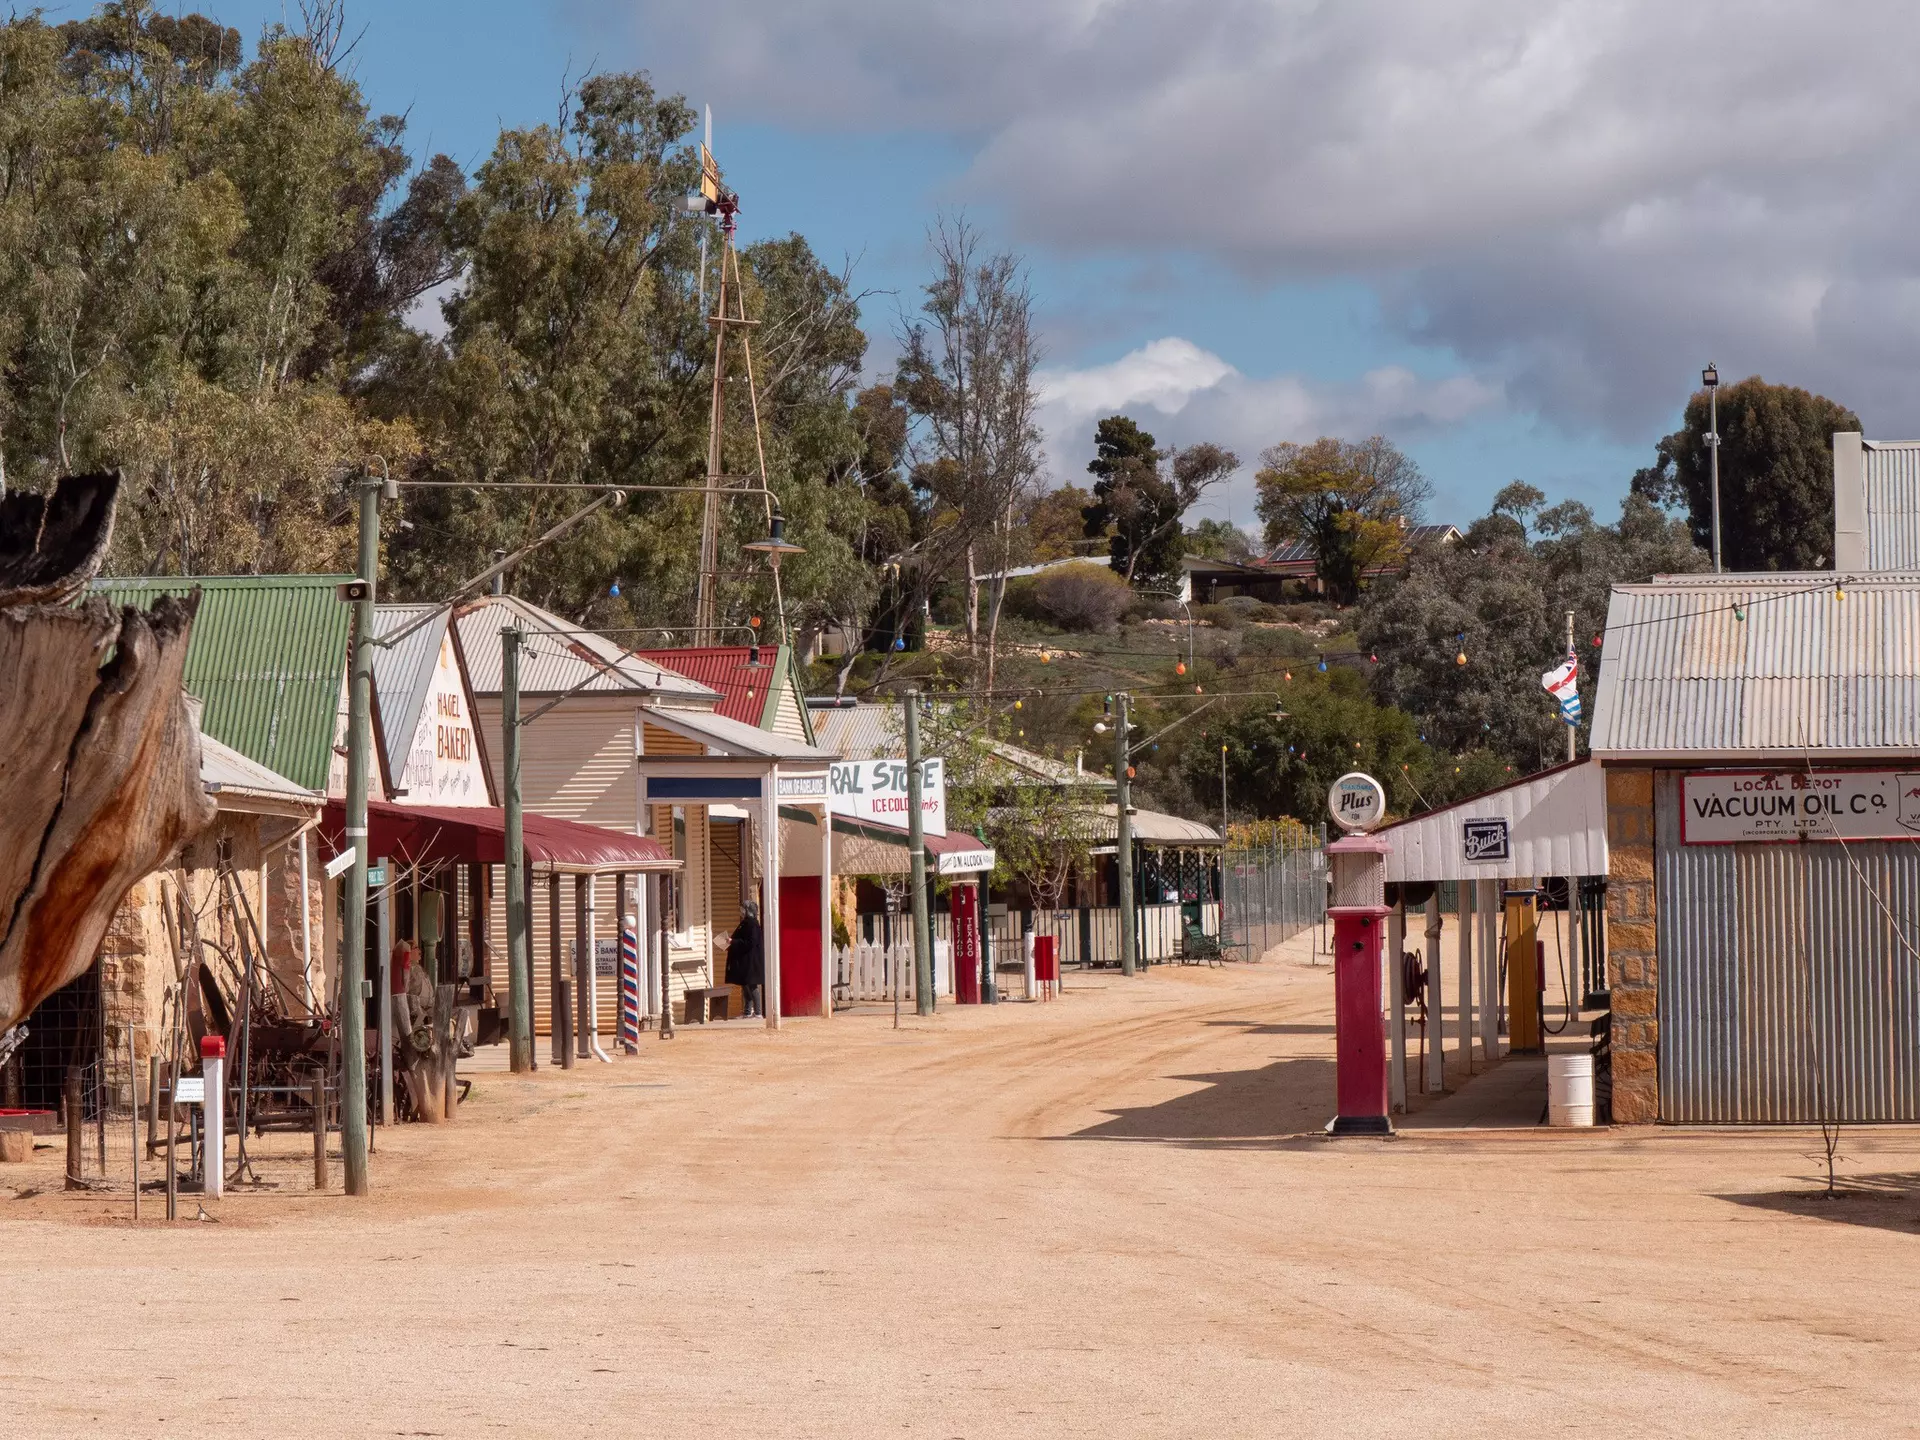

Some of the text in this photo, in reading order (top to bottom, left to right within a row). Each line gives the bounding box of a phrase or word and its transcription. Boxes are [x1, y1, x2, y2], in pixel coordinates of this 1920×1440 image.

[437, 725, 472, 763] BAKERY
[779, 779, 793, 794] BANK
[872, 762, 939, 792] STOE
[1734, 779, 1842, 791] LOCAL DEPOT
[872, 799, 887, 812] ICE
[1340, 792, 1372, 812] Plus
[1693, 796, 1795, 818] VACUUM
[1803, 794, 1844, 815] OIL
[1755, 819, 1820, 828] PTY. LTD.
[1466, 824, 1506, 860] Buick
